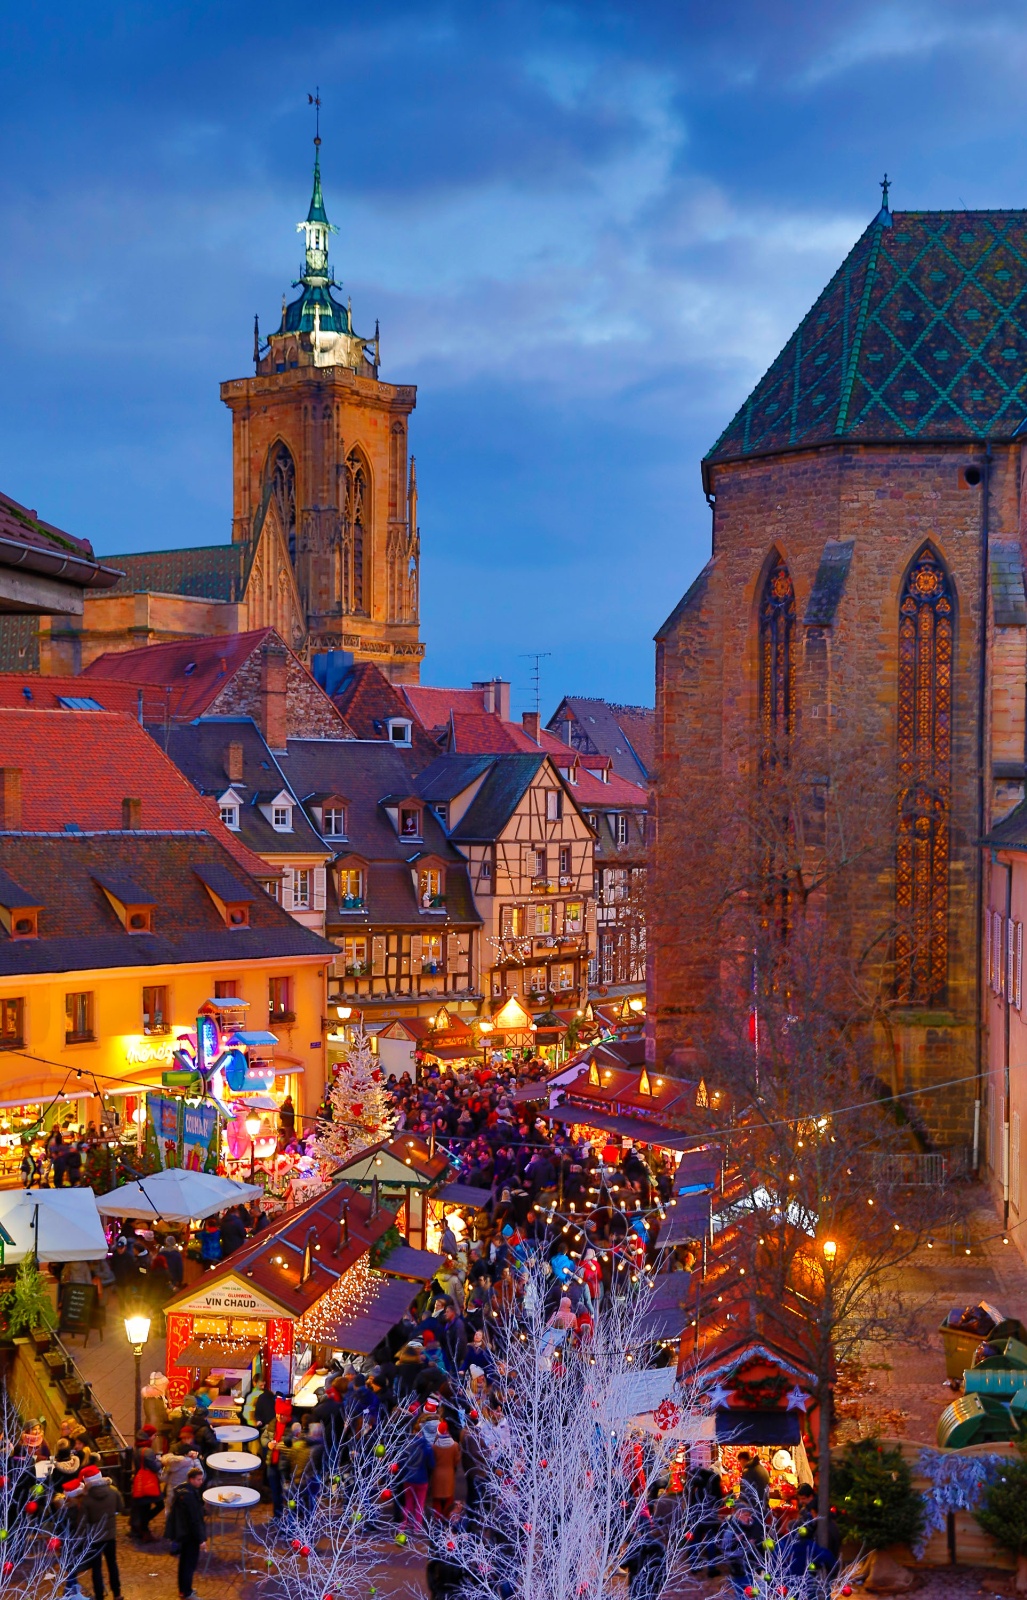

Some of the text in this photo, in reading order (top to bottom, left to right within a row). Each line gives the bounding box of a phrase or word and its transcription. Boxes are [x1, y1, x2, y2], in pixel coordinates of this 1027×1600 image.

[185, 1114, 209, 1138] COLMAR
[205, 1297, 222, 1306] VIN
[224, 1298, 257, 1308] CHAUD
